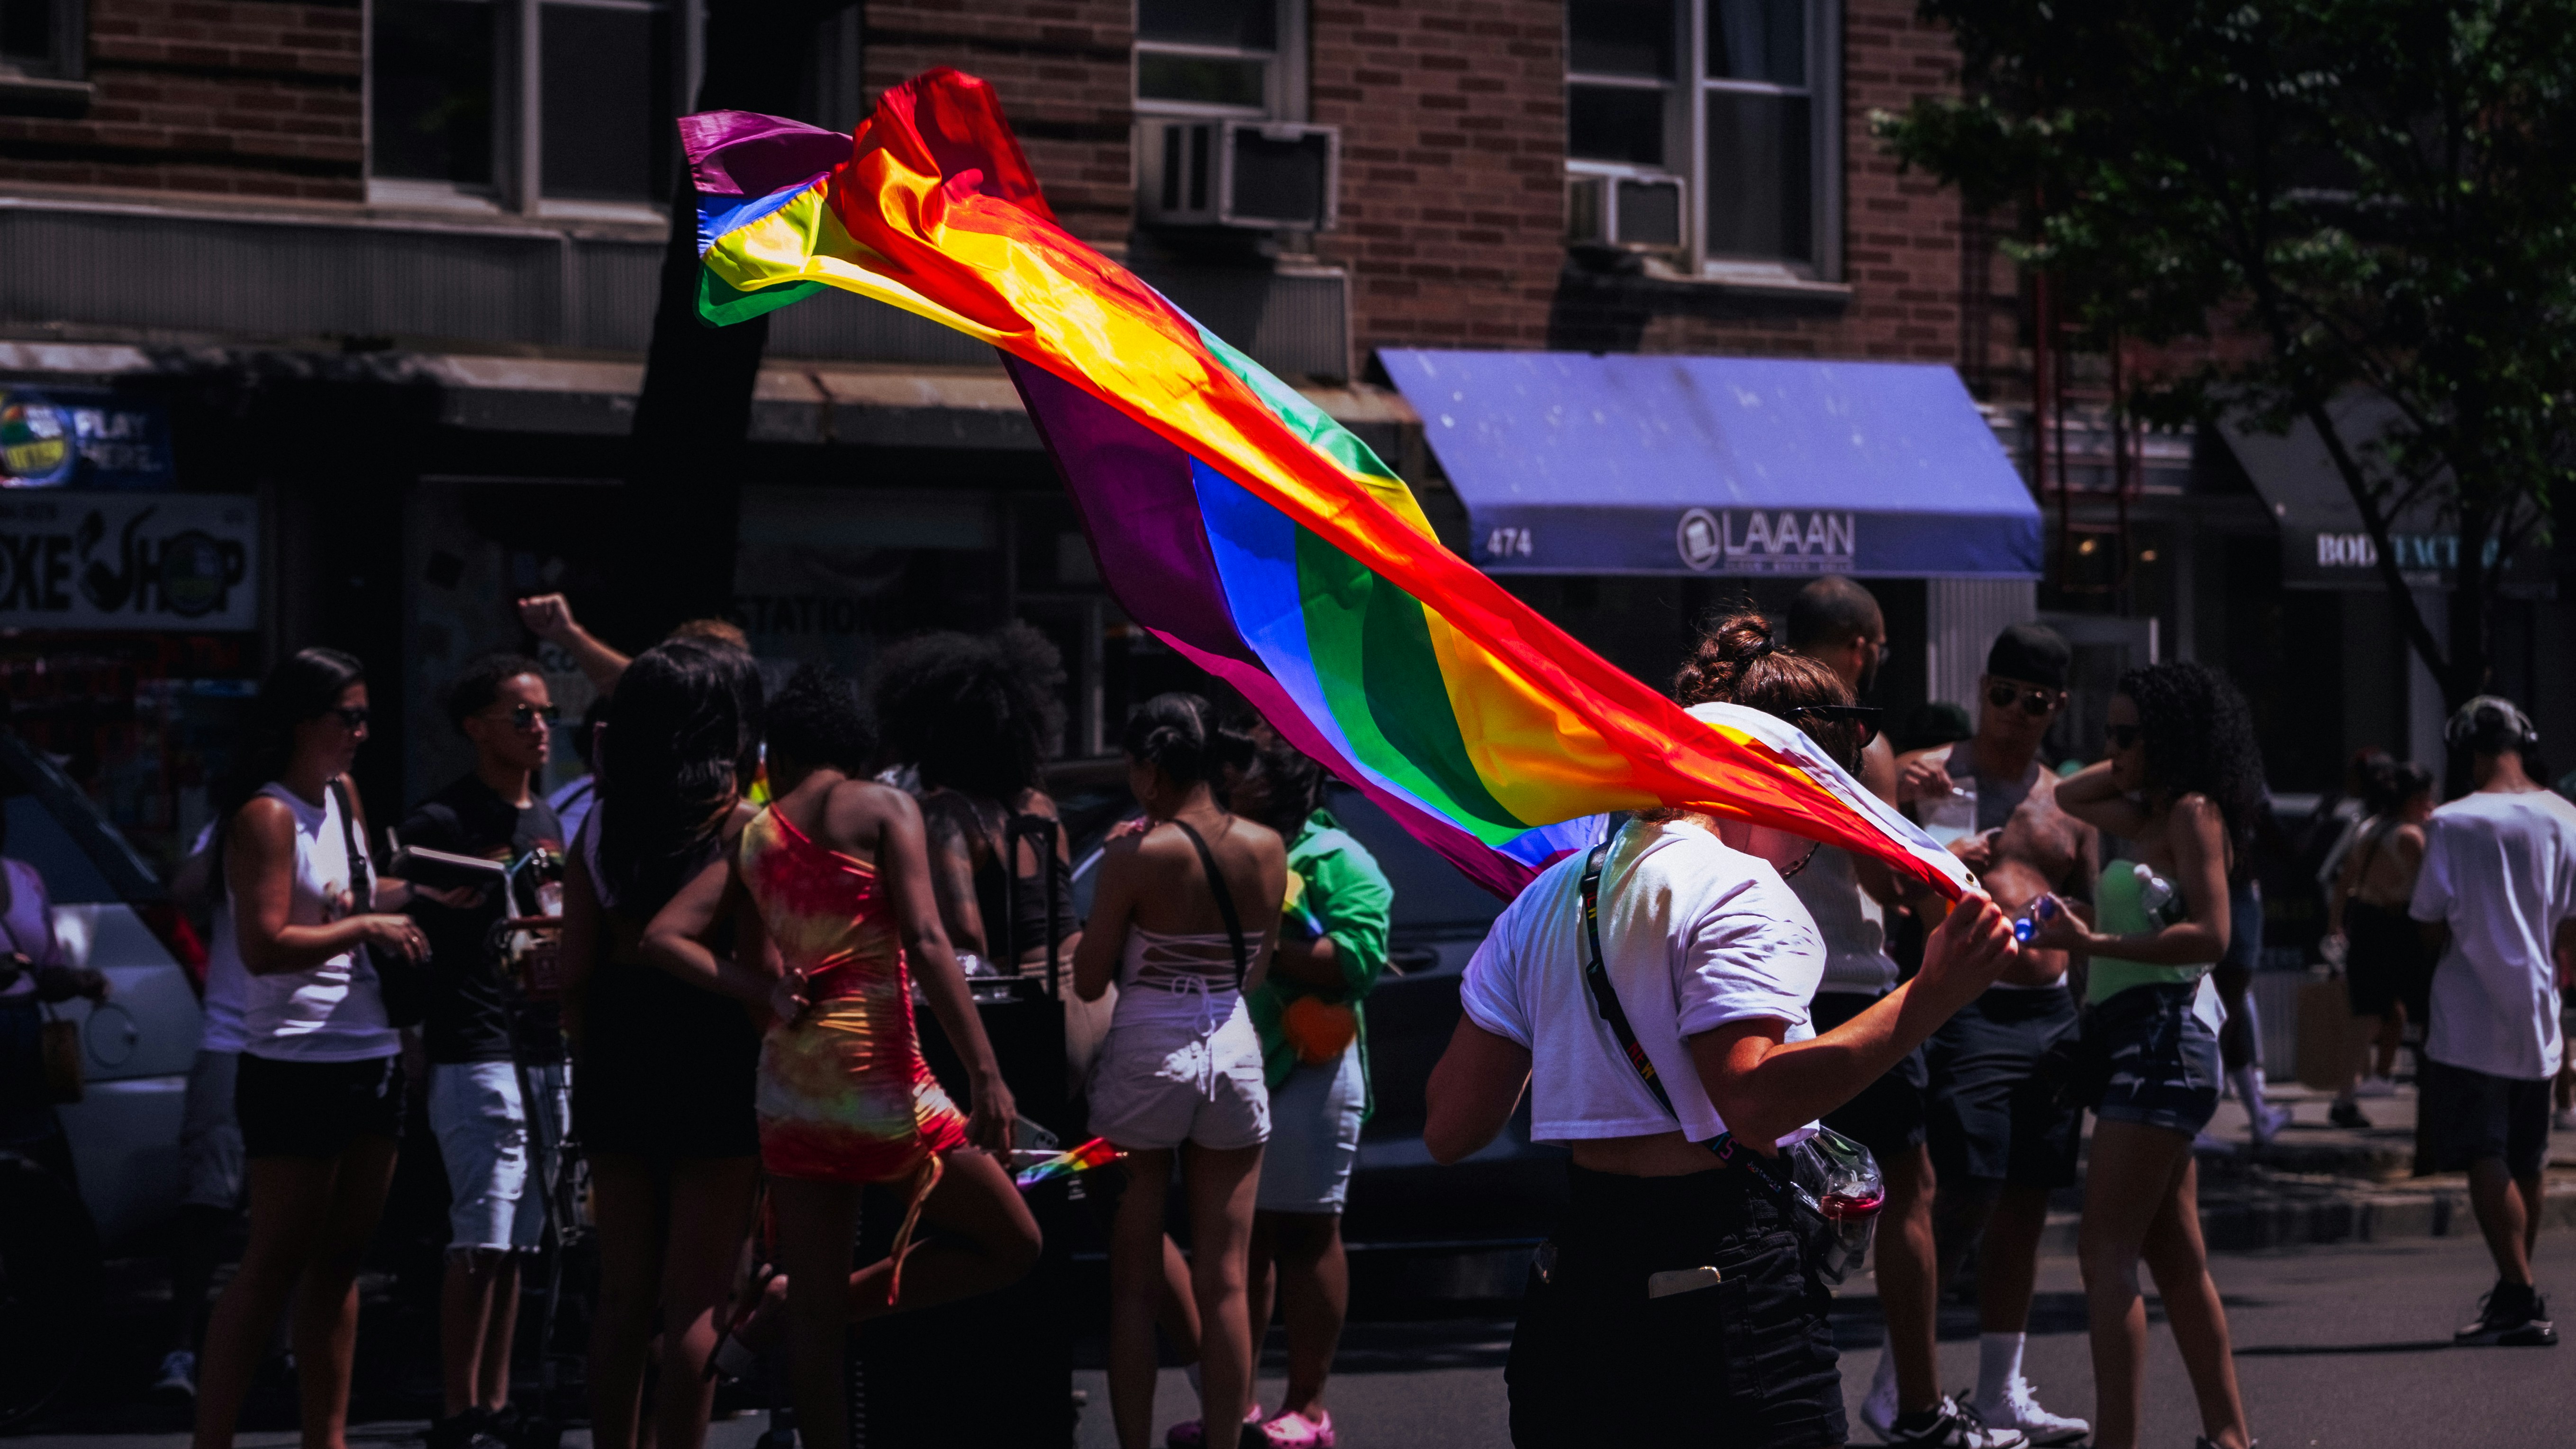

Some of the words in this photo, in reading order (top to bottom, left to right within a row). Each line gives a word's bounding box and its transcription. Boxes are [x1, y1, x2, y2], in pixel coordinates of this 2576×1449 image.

[74, 408, 149, 439] PLAY
[1487, 527, 1532, 557] 474
[1723, 509, 1855, 555] LAAAN
[2316, 532, 2394, 568] BOD
[1747, 1160, 1782, 1191] Justworks
